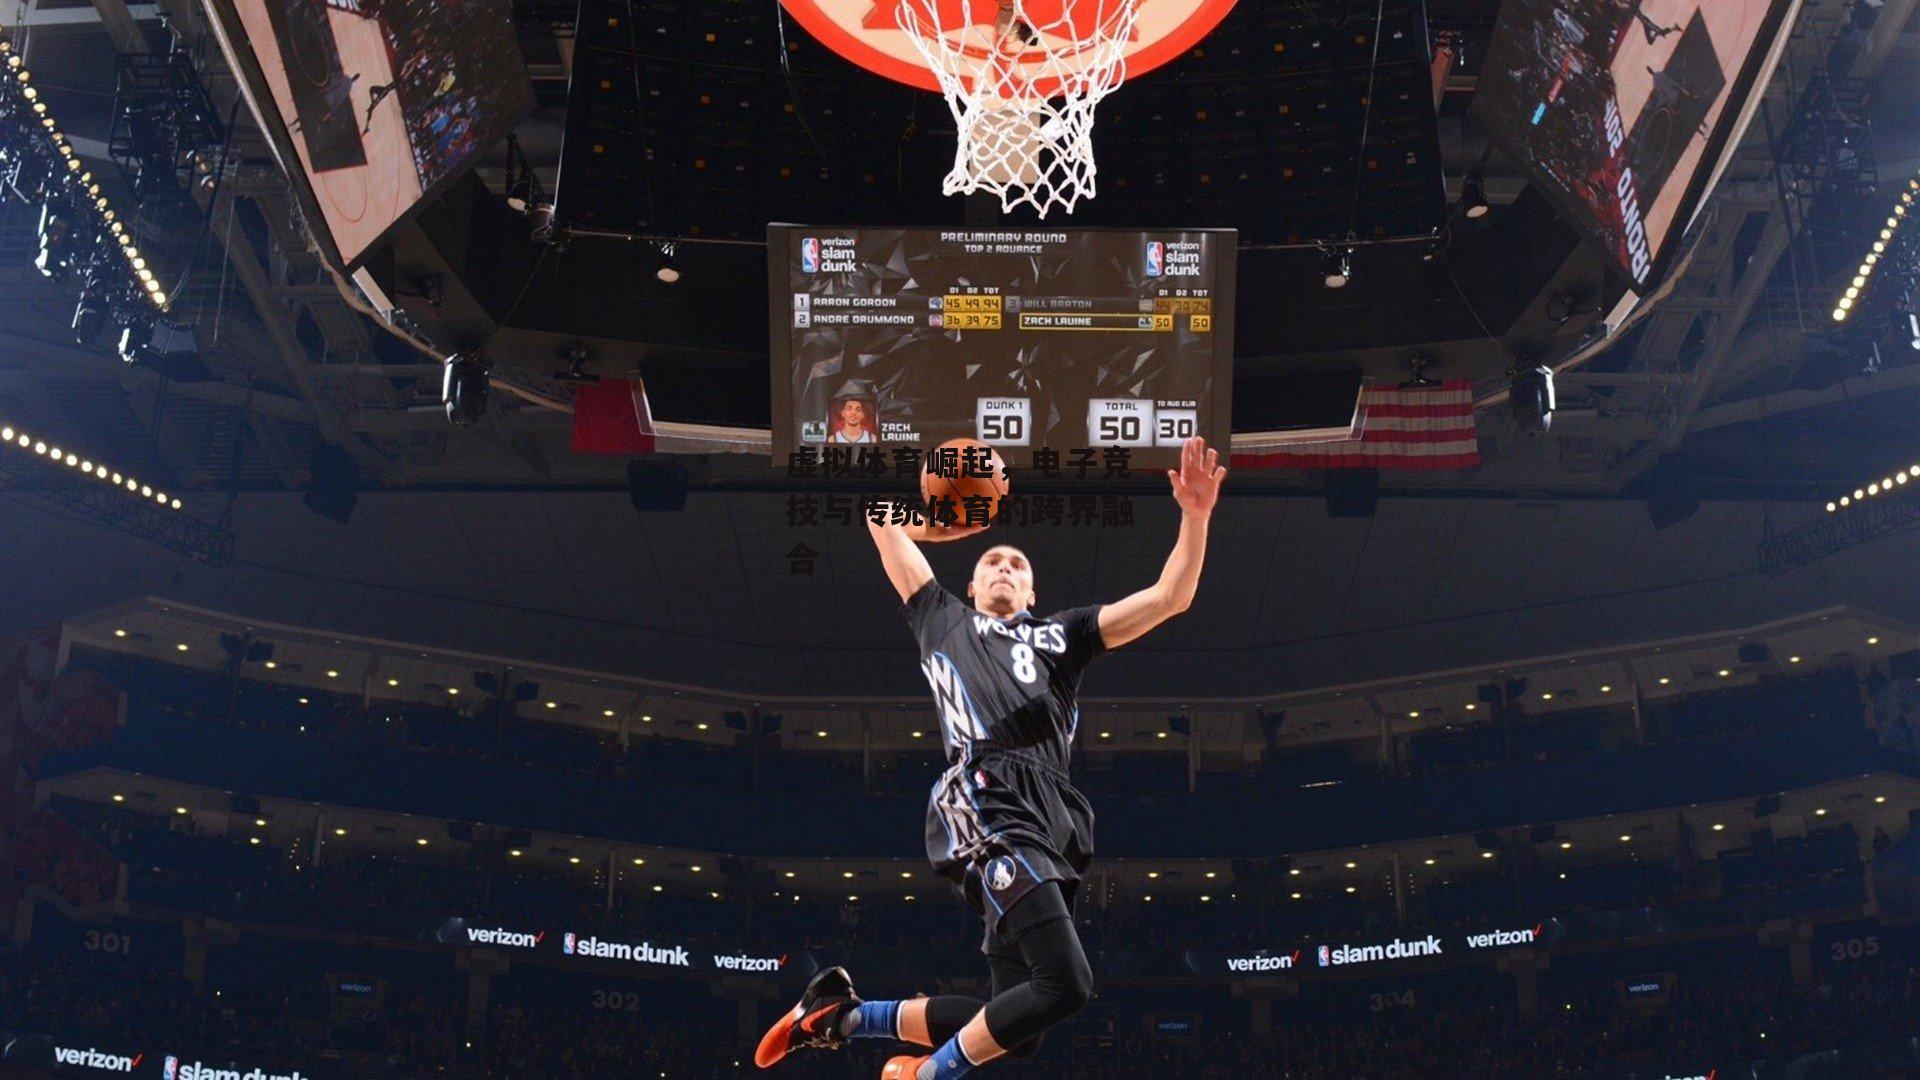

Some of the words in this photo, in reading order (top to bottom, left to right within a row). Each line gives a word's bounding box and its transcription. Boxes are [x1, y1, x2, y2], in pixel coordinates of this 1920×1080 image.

[821, 237, 856, 247] verizon
[940, 232, 1022, 242] PRELIMINARY
[1024, 233, 1067, 243] ROUND
[964, 244, 984, 252] TOP
[986, 244, 993, 252] 2
[1165, 241, 1200, 250] verizon
[821, 246, 856, 259] slam
[1165, 250, 1200, 263] slam
[821, 260, 857, 272] dunk
[1165, 264, 1200, 276] dunk
[813, 298, 848, 307] AARON
[852, 298, 897, 307] GORDON
[813, 315, 849, 324] ANDRE
[852, 315, 915, 324] DRUMMOND
[1024, 316, 1052, 325] ZACH
[1193, 318, 1208, 328] 50
[986, 400, 1015, 410] DUNK
[1018, 400, 1023, 410] 1
[1105, 402, 1138, 411] TOTAL
[881, 423, 911, 432] ZACH
[983, 415, 1023, 440] 50
[1100, 416, 1140, 440] 50
[1159, 418, 1194, 439] 30
[881, 432, 920, 442] LAVINE
[973, 615, 1066, 654] WOLVES
[1011, 642, 1036, 684] 8
[84, 930, 132, 955] 301
[467, 927, 536, 947] verizon
[1467, 928, 1534, 948] verizon
[577, 936, 631, 960] slam
[634, 941, 690, 966] dunk
[1331, 944, 1384, 965] slam
[1385, 935, 1442, 959] dunk
[1831, 935, 1880, 962] 305
[714, 953, 779, 971] verizon
[1227, 953, 1292, 971] verizon
[1628, 981, 1660, 992] verizon
[592, 990, 640, 1012] 302
[54, 1047, 132, 1072] verizon
